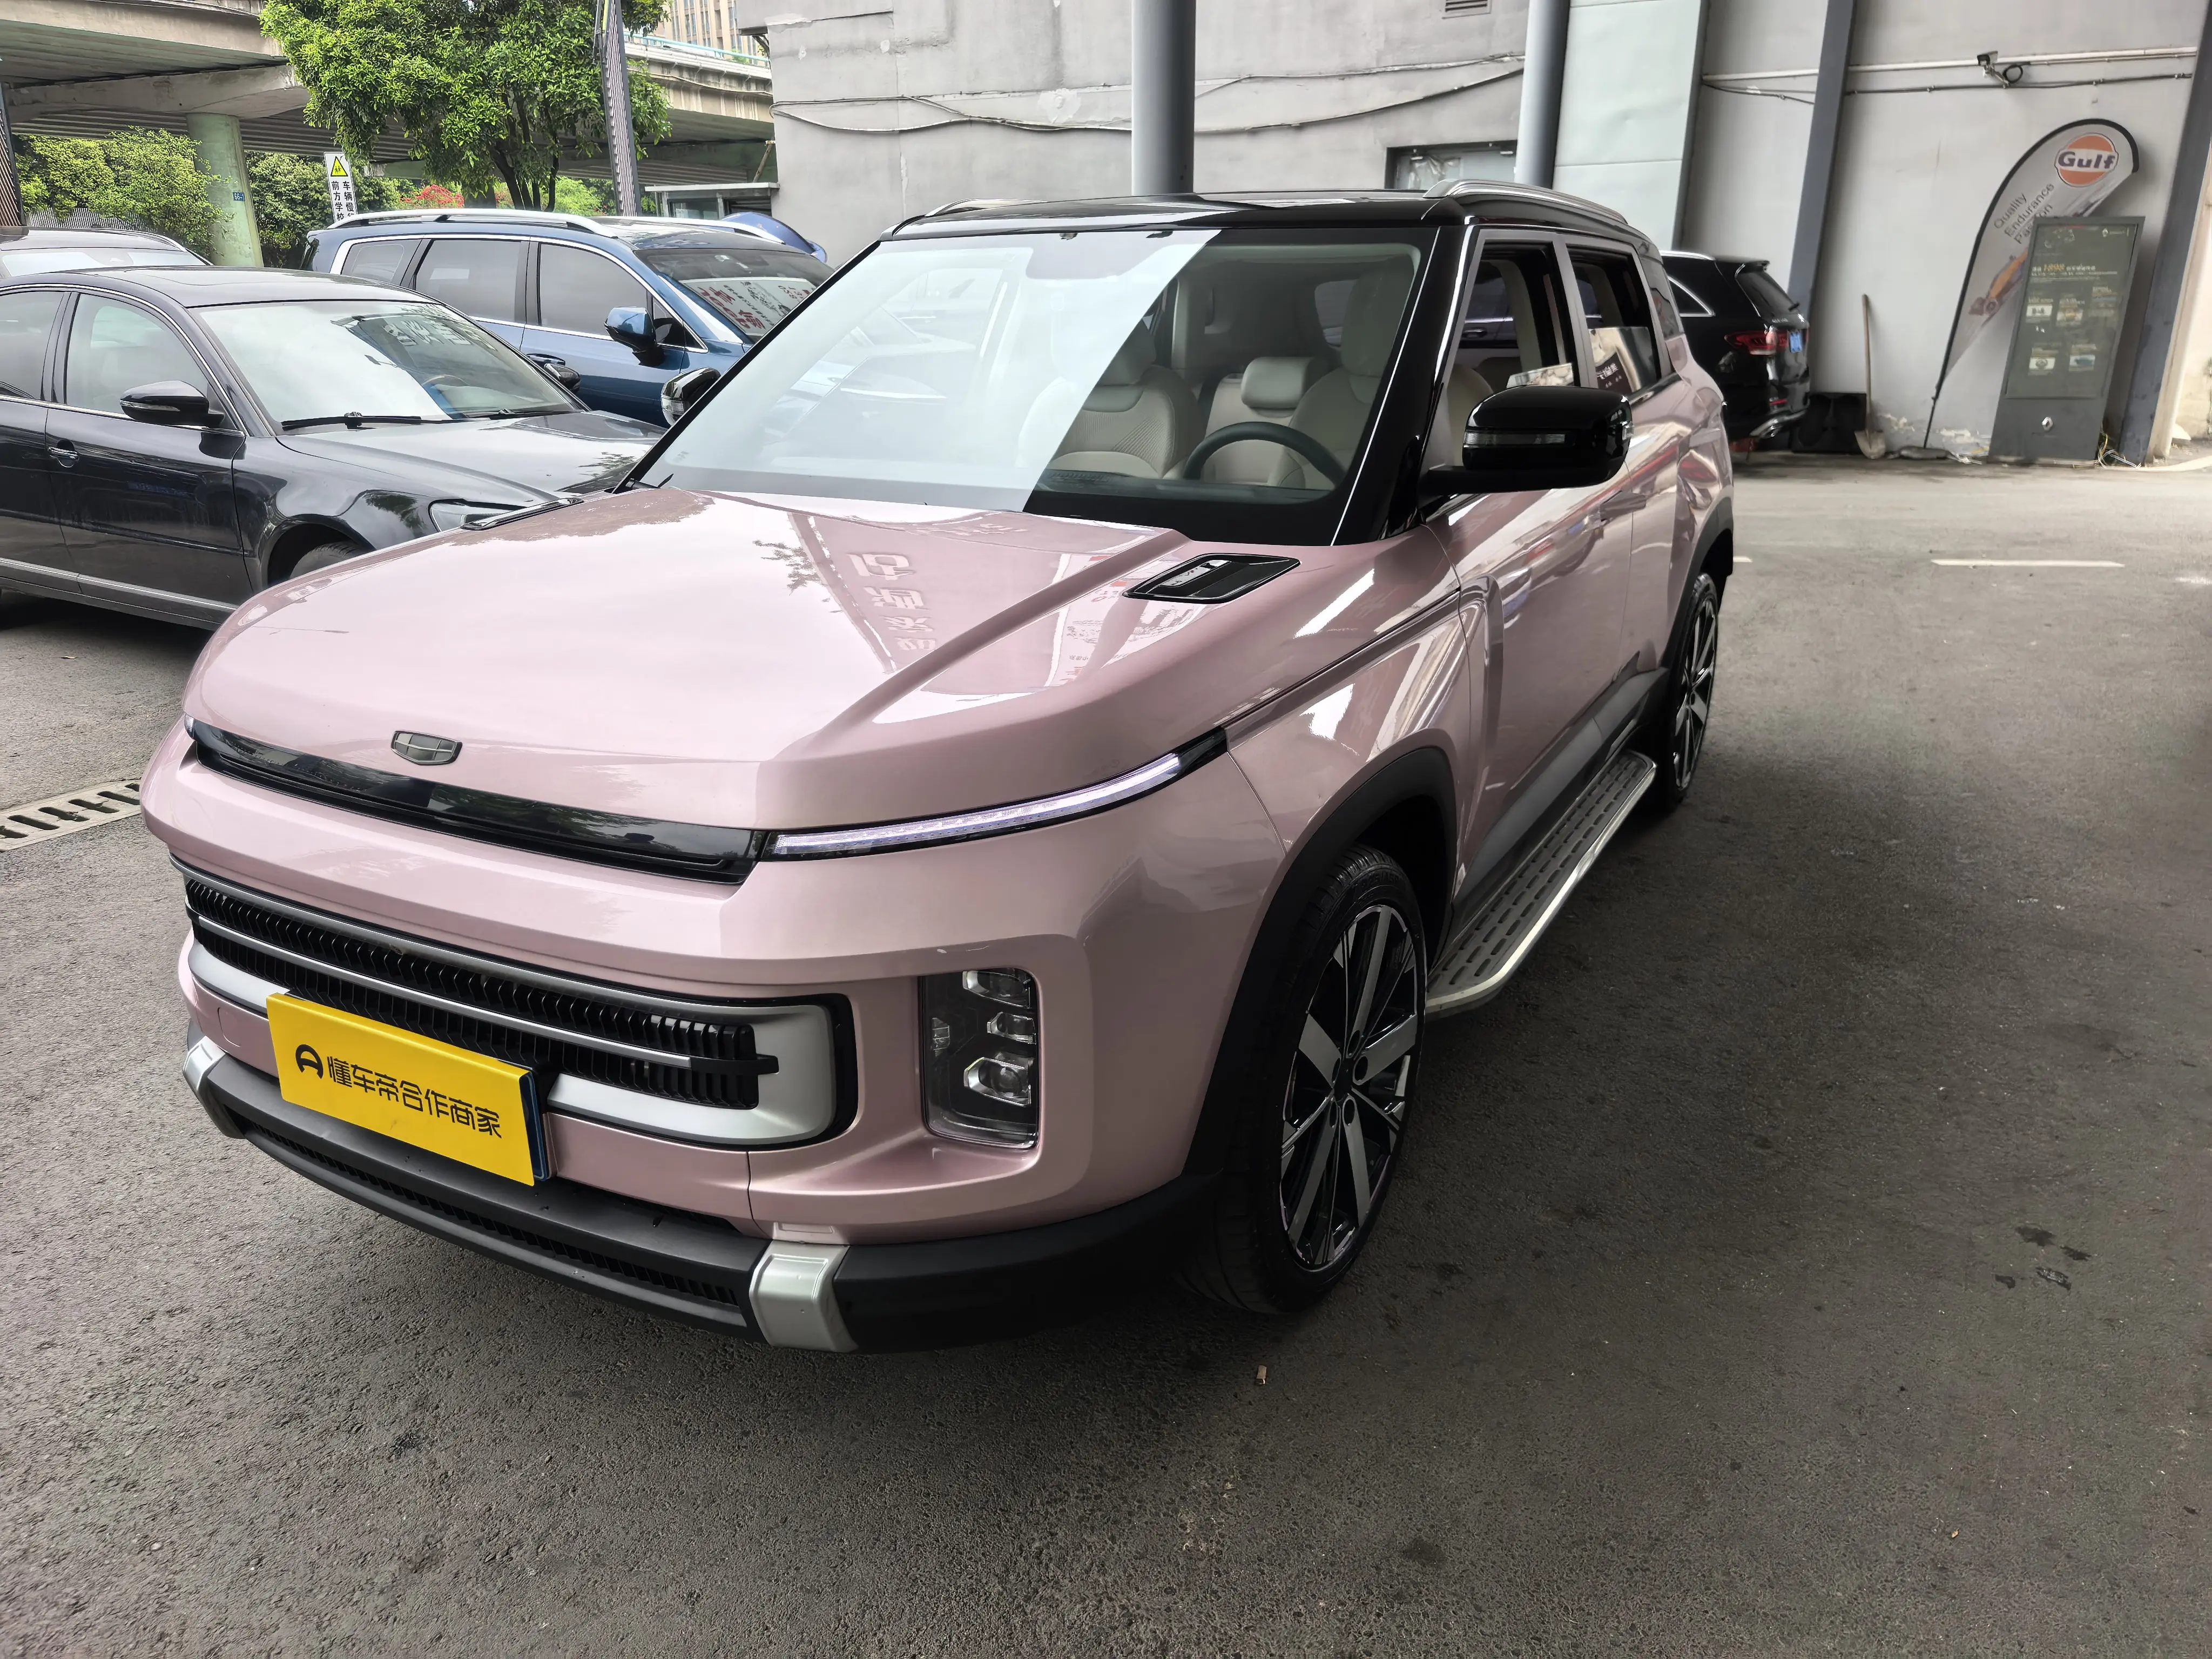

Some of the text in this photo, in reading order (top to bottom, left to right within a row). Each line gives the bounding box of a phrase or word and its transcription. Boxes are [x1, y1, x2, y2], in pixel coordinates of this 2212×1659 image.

[2058, 151, 2115, 169] Gulf
[331, 181, 345, 220] 前方学校
[1994, 193, 2027, 229] Quality
[2004, 183, 2054, 238] Endurance
[327, 1056, 502, 1139] 懂车帝合作商家
